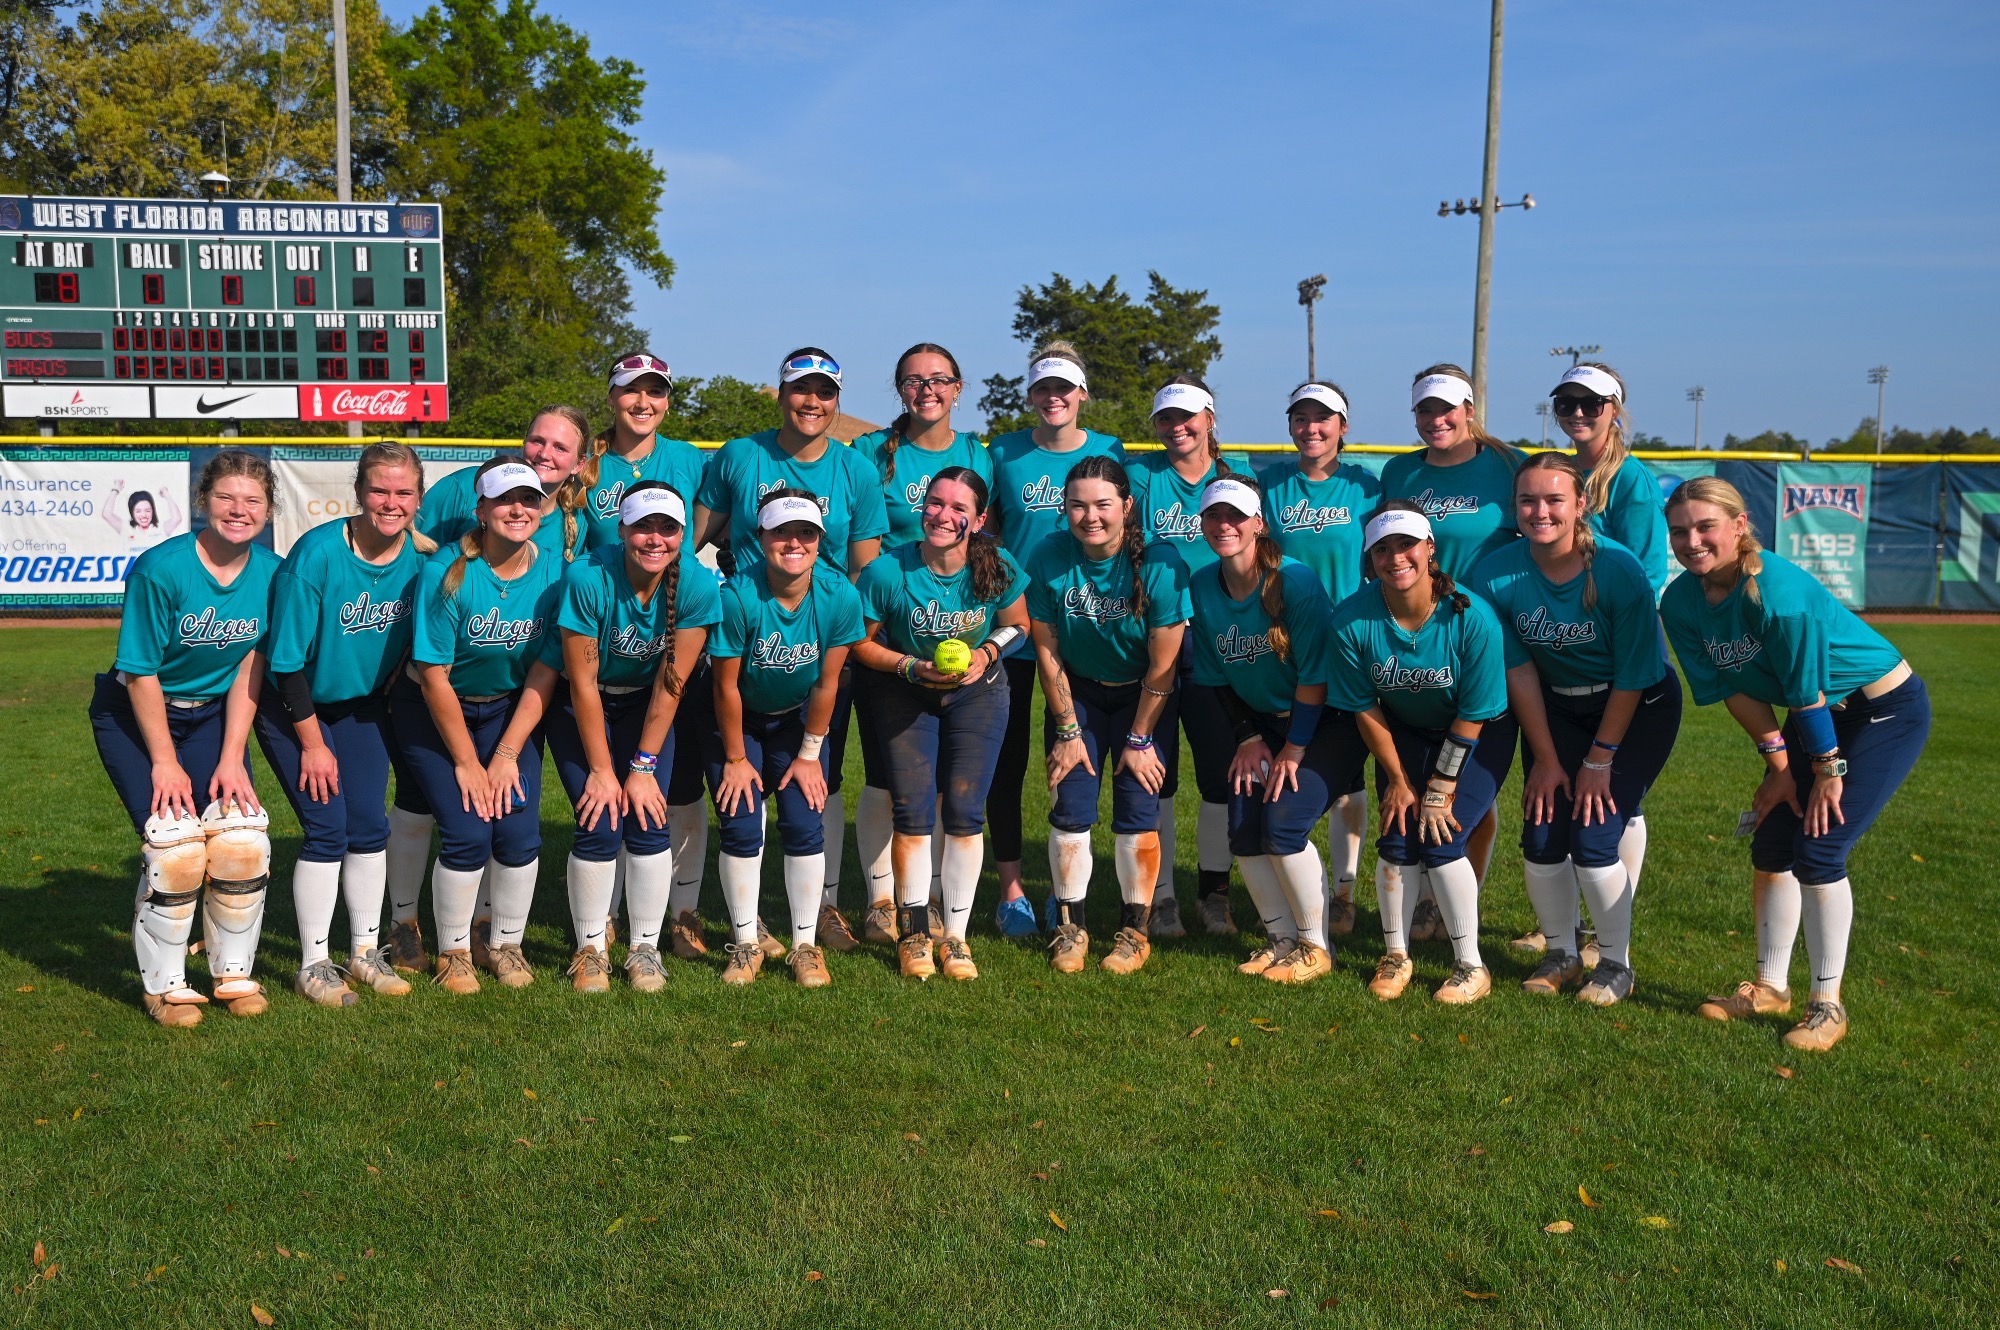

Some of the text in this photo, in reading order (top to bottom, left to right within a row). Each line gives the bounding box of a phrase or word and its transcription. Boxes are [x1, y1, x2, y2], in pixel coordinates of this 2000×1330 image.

[32, 203, 389, 233] WEST FLORIDA ARGONAUTS
[25, 241, 84, 268] AT BAT
[130, 243, 173, 269] BALL
[199, 244, 263, 271] STRIKE
[285, 245, 321, 271] OUT
[355, 246, 369, 272] H
[408, 246, 419, 273] E
[58, 272, 79, 304] 8
[143, 273, 163, 305] 0
[222, 275, 242, 305] 0
[295, 275, 314, 305] 0
[117, 312, 437, 329] 1 2 3 4 5 6 7 8 9 10 RUNS HITS ERRORS
[4, 328, 423, 351] BUCS 0 0 0 0 0 0 0 2 0
[115, 356, 130, 378] 0
[135, 356, 149, 378] 3
[153, 356, 167, 378] 2
[172, 357, 186, 379] 2
[191, 357, 205, 379] 0
[210, 357, 224, 379] 3
[327, 358, 347, 379] 10
[368, 358, 388, 379] 11
[410, 358, 424, 379] 2
[44, 406, 109, 416] BSN SPORTS
[332, 389, 411, 415] Coca-Cola
[0, 475, 92, 492] Insurance
[1, 500, 94, 517] 434-2460
[1784, 486, 1862, 516] NAIA
[1153, 501, 1203, 543] Arg
[1280, 499, 1351, 534] Argos
[12, 540, 67, 554] Offering
[1789, 533, 1856, 557] 1993
[178, 606, 260, 650] Argos
[339, 591, 412, 636] Argos
[467, 607, 544, 650] Argos
[910, 599, 987, 637] Argos
[1516, 606, 1597, 650] Argos
[608, 622, 668, 662] Argo
[750, 631, 822, 674] Argos
[1370, 654, 1454, 693] Argos
